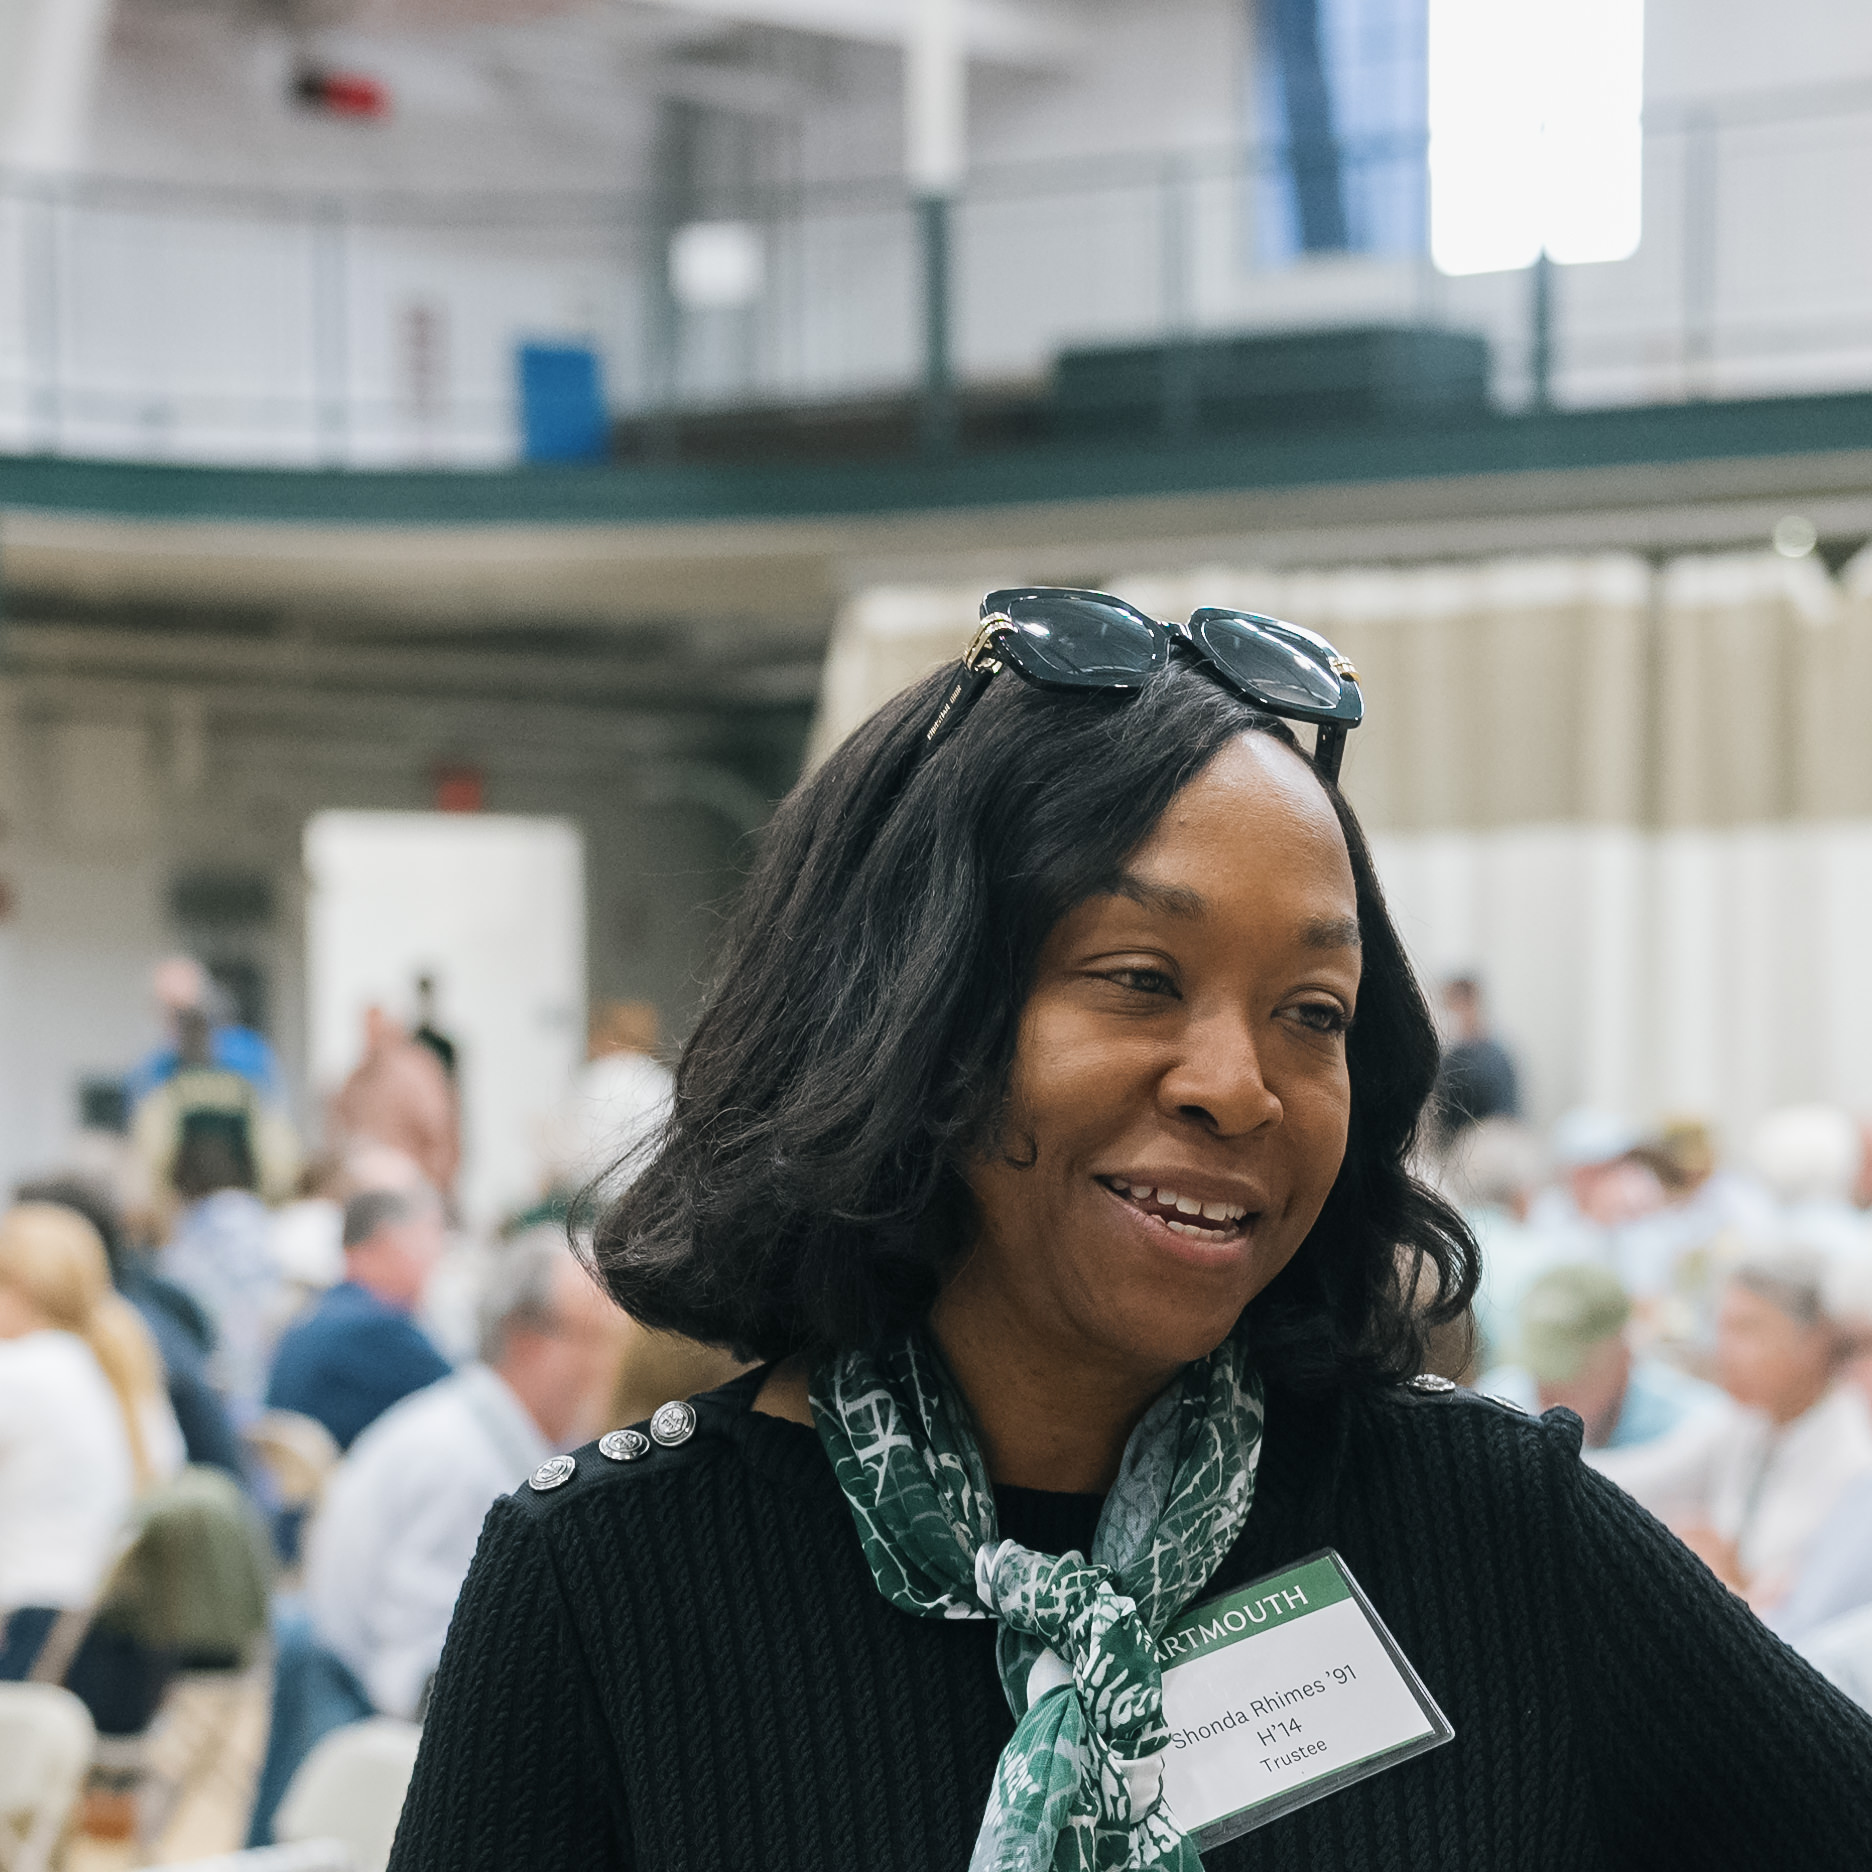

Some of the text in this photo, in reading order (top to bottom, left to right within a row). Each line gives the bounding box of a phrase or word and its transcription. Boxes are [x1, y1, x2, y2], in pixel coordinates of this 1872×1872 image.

[1172, 1711, 1250, 1750] Shonda
[1250, 1680, 1326, 1718] Rhimes
[1259, 1738, 1328, 1774] Trustee
